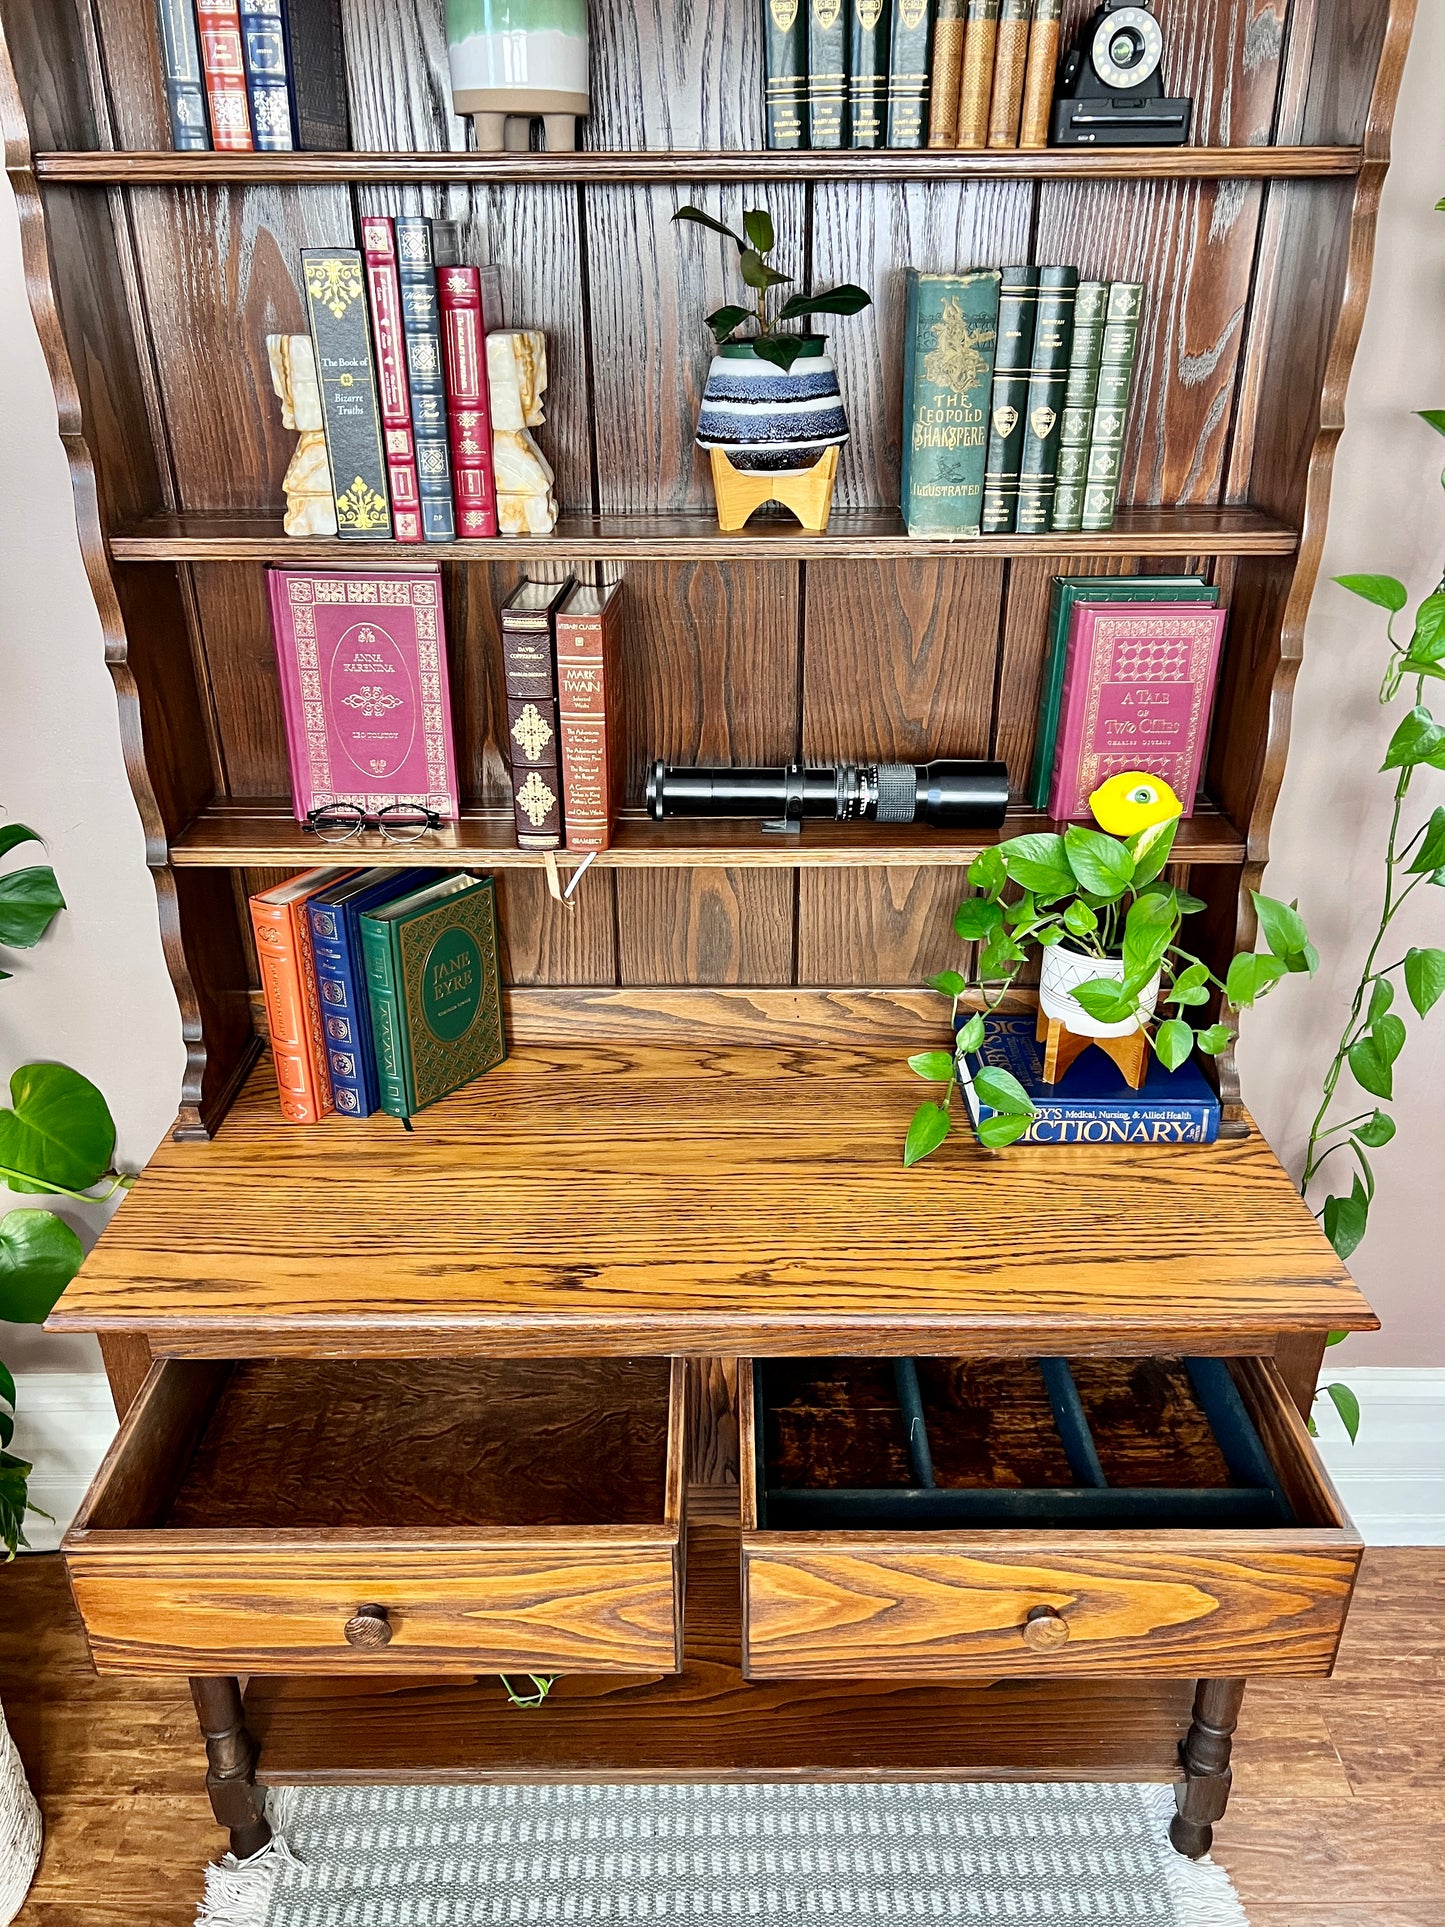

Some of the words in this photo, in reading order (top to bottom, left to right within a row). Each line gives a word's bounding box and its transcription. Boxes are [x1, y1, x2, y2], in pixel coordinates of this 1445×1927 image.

[321, 357, 338, 367] The
[338, 357, 359, 367] Book
[359, 357, 369, 367] of
[334, 393, 364, 403] Bizarre
[933, 393, 973, 409] THE
[336, 404, 364, 415] Truths
[919, 405, 983, 426] LEOPOLD
[914, 422, 985, 451] SHAKSPERE
[913, 482, 980, 497] ILLUSTRATED
[578, 623, 602, 631] CLASSICS
[353, 653, 384, 663] ANNA
[343, 663, 396, 673] KARENINA
[566, 670, 596, 680] MARK
[563, 680, 600, 692] TWAIN
[1120, 691, 1135, 705] A
[569, 783, 575, 791] A
[432, 951, 471, 986] JANE
[434, 969, 473, 1001] EYRE
[1065, 1110, 1098, 1120] Medical,
[1098, 1110, 1131, 1120] Nursing,
[1132, 1110, 1141, 1119] &
[1141, 1111, 1165, 1120] Allied
[1166, 1111, 1192, 1120] Health
[1021, 1120, 1196, 1142] ICTIONARY
